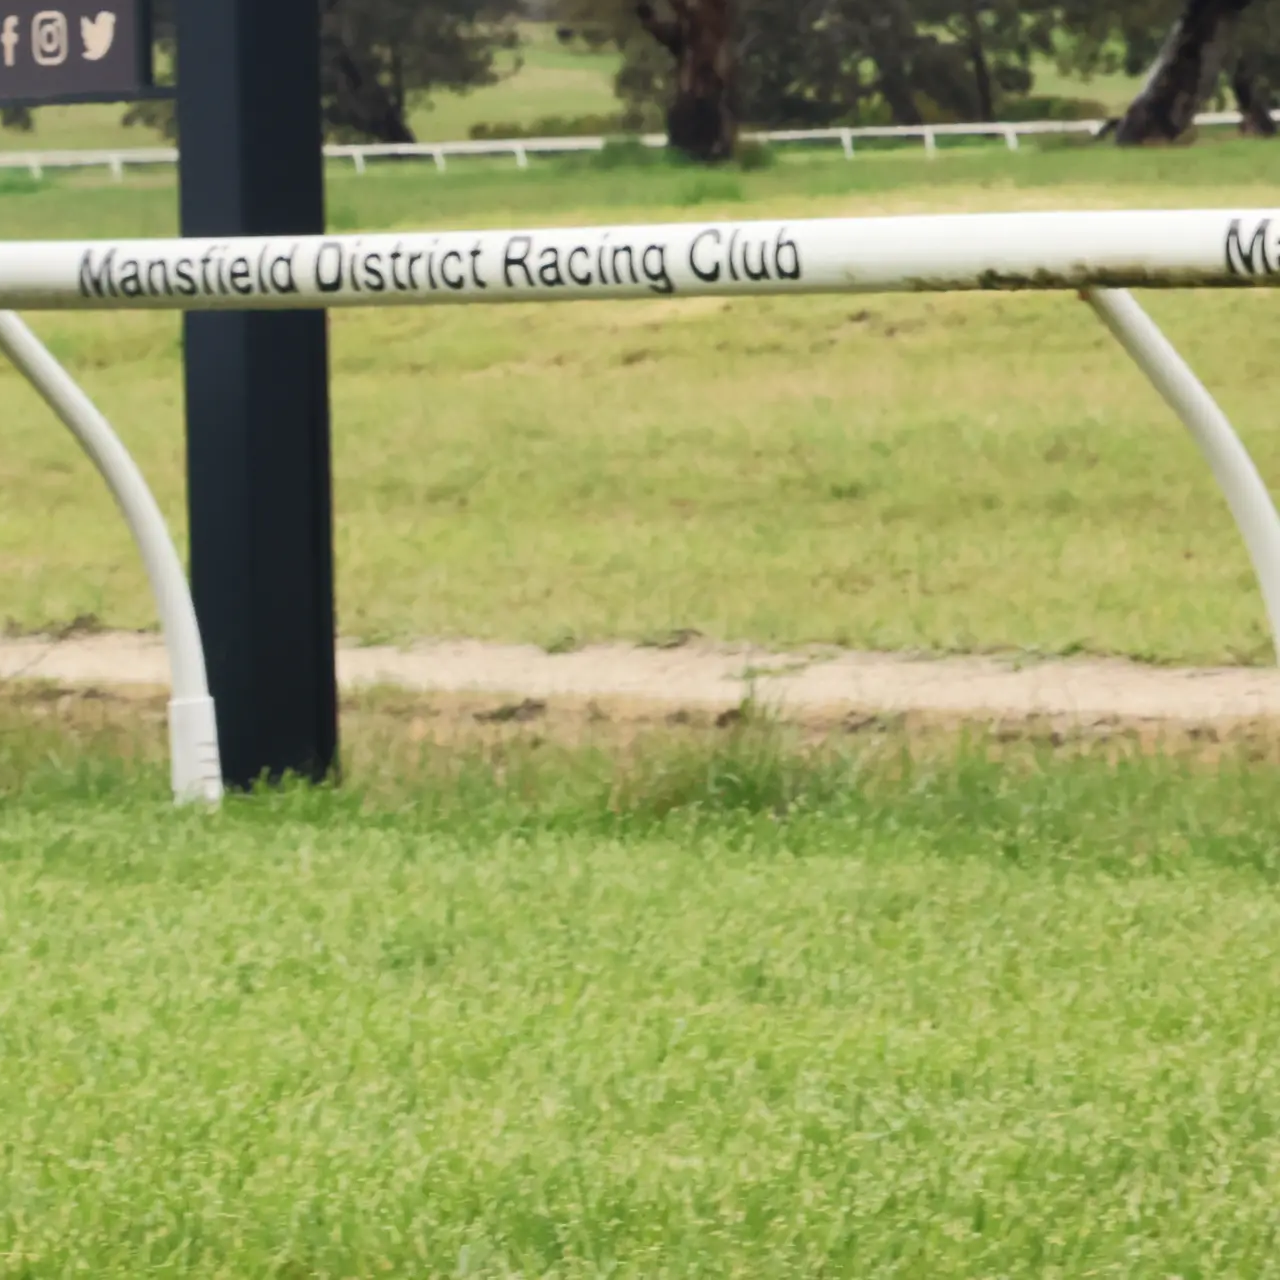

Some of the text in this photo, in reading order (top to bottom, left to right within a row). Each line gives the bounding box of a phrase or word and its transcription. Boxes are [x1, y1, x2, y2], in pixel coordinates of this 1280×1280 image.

[77, 226, 802, 299] Mansfield District Racing Club
